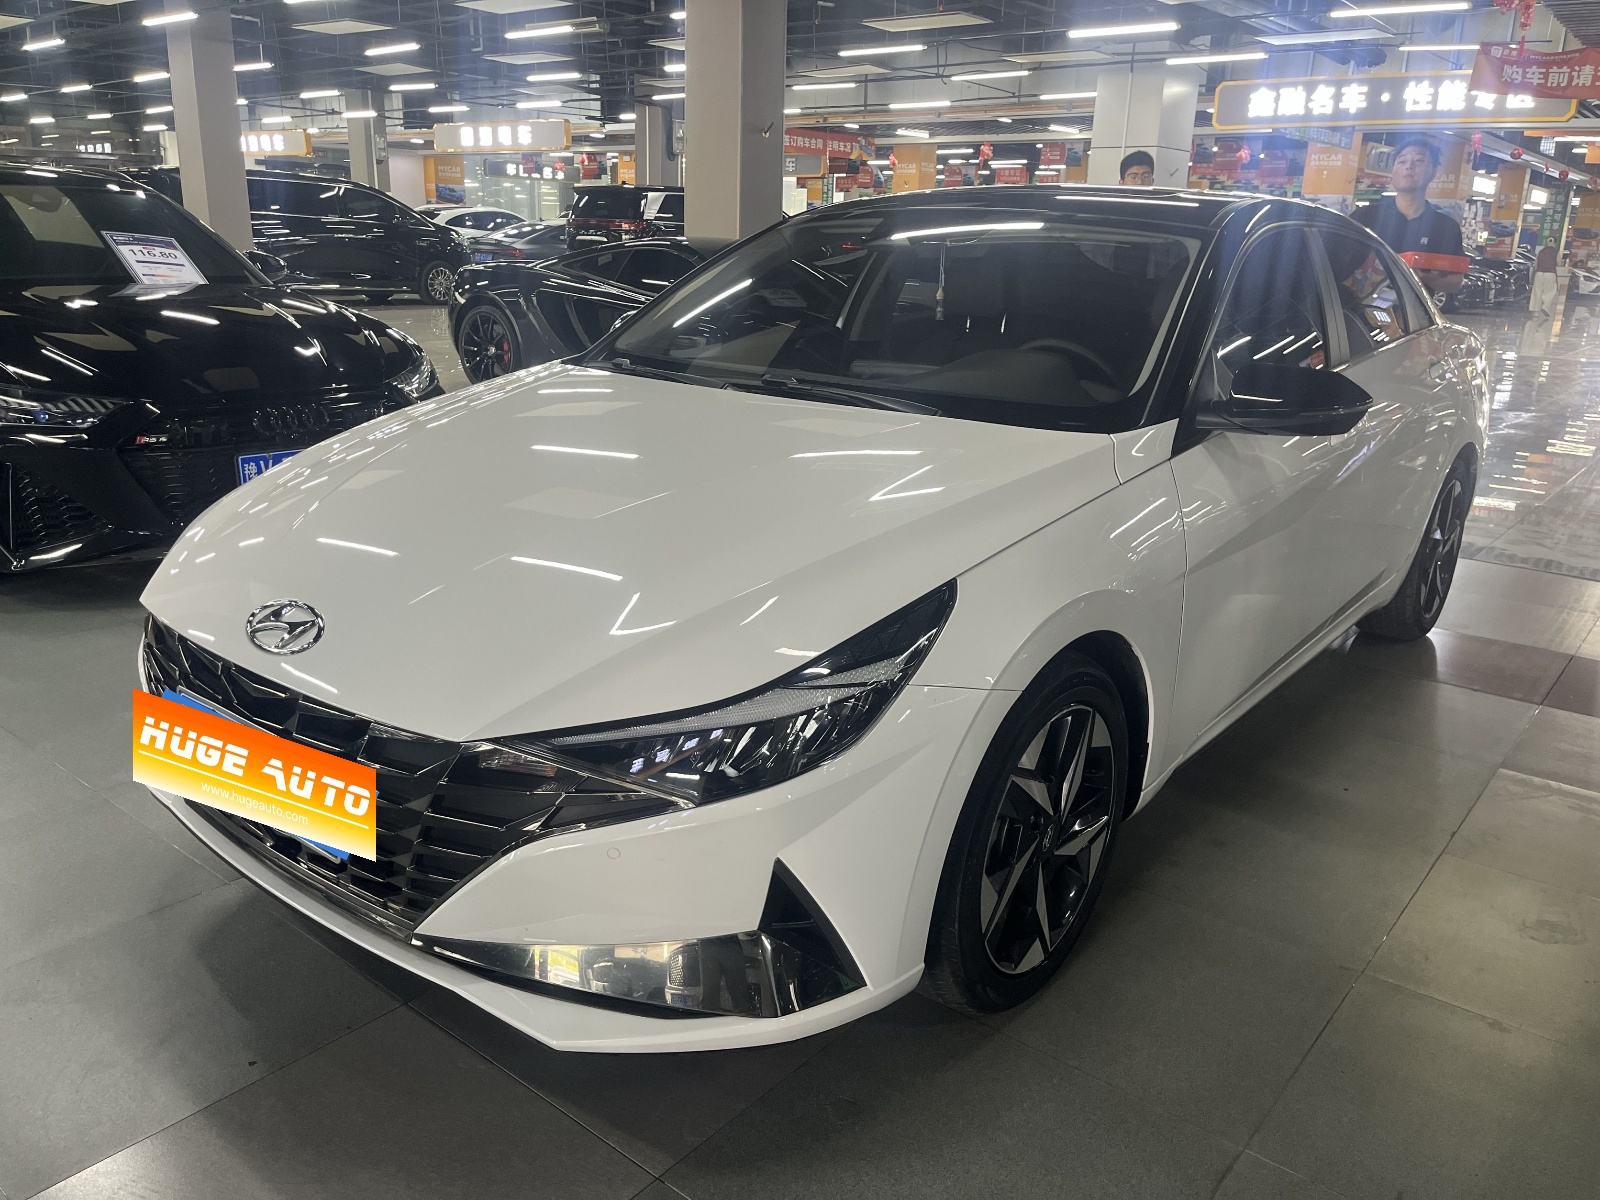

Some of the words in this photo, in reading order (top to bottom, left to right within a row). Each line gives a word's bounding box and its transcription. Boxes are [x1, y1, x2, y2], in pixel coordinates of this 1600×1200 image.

[1501, 63, 1600, 88] 购车前请
[1311, 153, 1342, 161] MYCAR
[438, 165, 461, 173] MYCAR
[128, 248, 178, 260] 116.80
